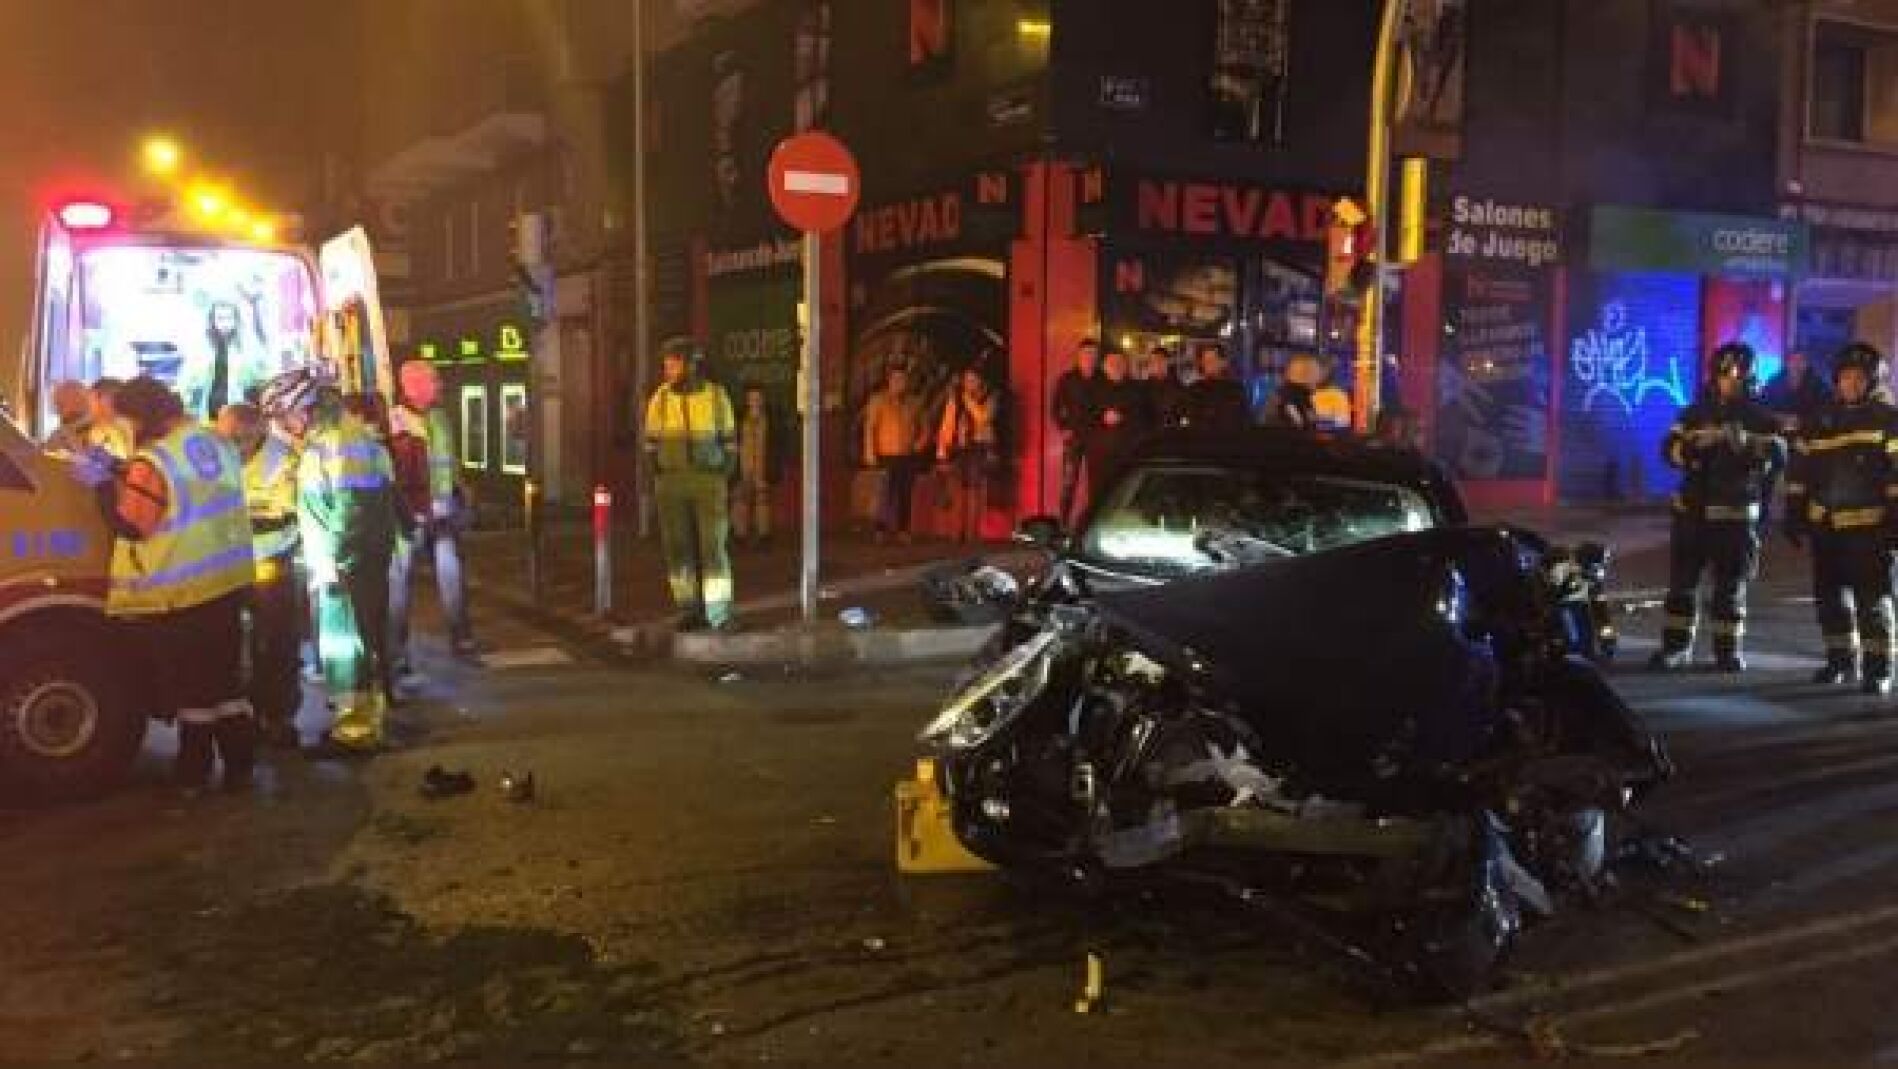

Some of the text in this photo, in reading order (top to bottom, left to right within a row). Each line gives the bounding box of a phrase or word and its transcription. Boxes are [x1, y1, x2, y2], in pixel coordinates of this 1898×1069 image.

[1671, 25, 1720, 94] N
[979, 173, 1006, 204] N
[856, 192, 961, 253] NEVAD
[1453, 196, 1551, 228] Salones
[1483, 231, 1557, 267] Juego
